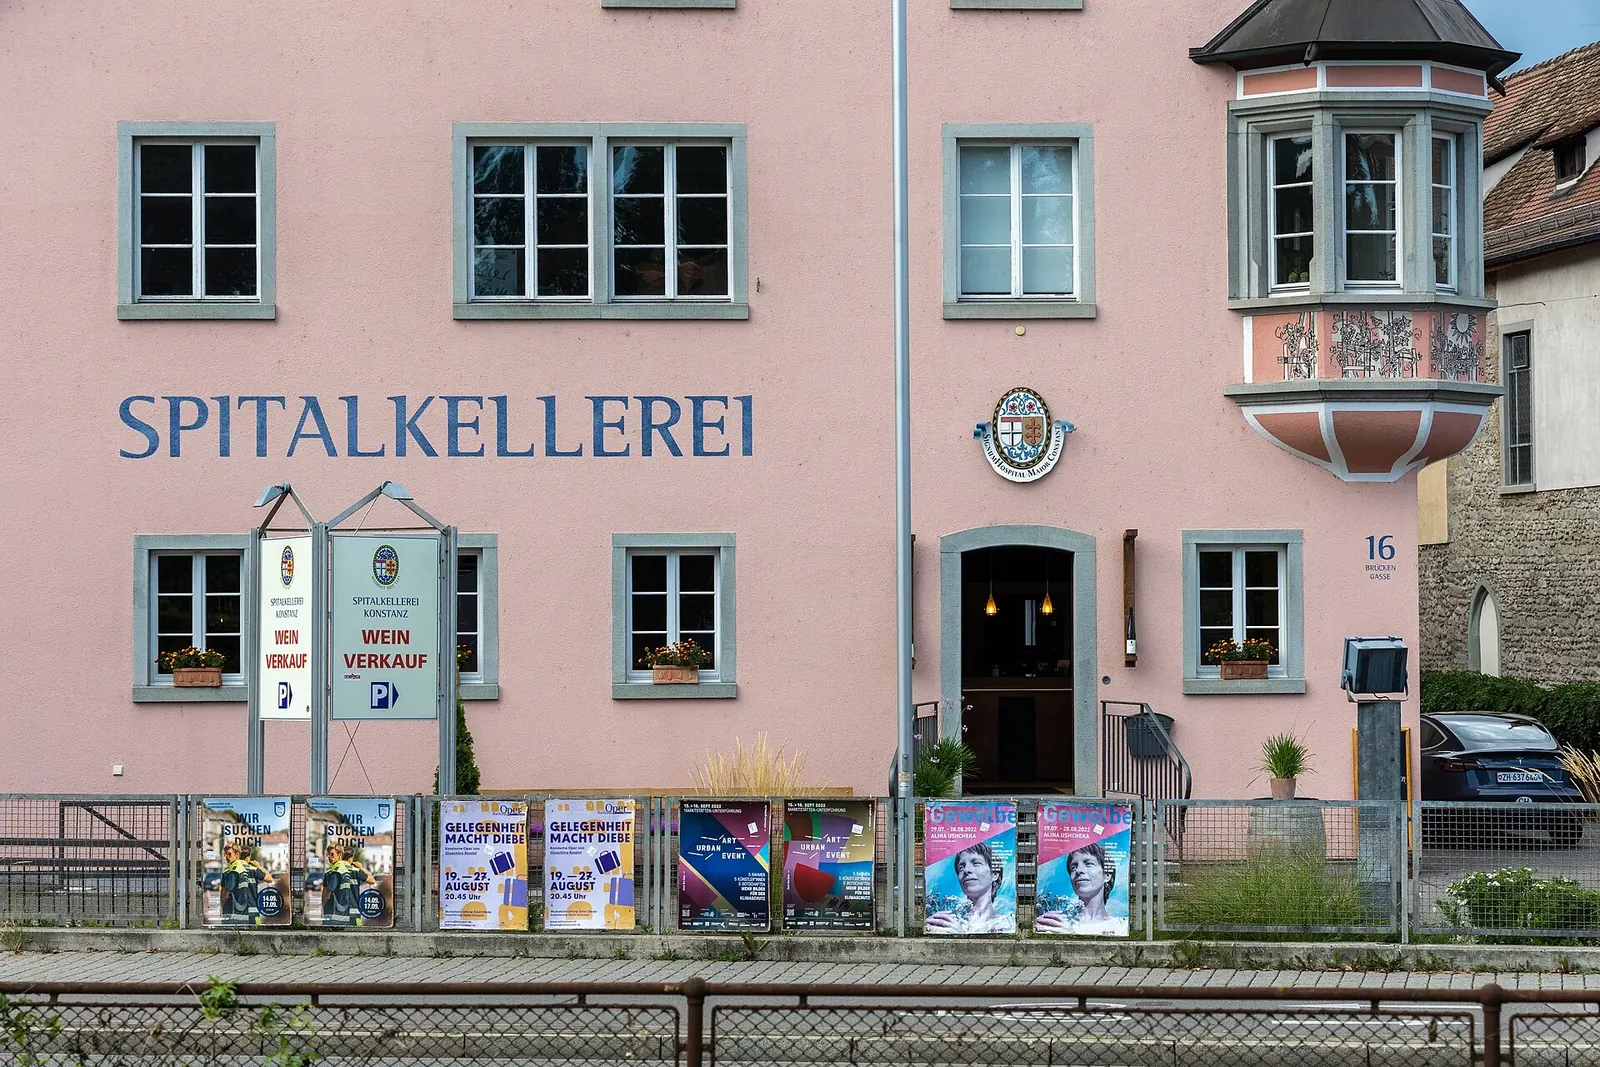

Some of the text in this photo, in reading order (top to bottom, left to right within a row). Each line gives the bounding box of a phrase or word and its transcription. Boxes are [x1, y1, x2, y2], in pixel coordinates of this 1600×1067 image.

[118, 395, 754, 459] SPITALKELLEREI
[1365, 535, 1395, 560] 16
[270, 597, 304, 606] SPITALKELLEREI
[352, 597, 419, 606] SPITALKELLEREI
[275, 609, 298, 618] KONSTANZ
[363, 609, 409, 618] KONSTANZ
[274, 630, 299, 645] WEIN
[361, 630, 410, 645] WEIN
[266, 653, 307, 669] VERKAUF
[343, 653, 427, 669] VERKAUF
[279, 684, 288, 707] P
[372, 684, 388, 707] P
[500, 805, 522, 816] Oper
[605, 803, 627, 814] Oper
[1043, 803, 1132, 825] Gewölbe
[236, 813, 259, 824] WIR
[339, 814, 363, 824] WIR
[224, 825, 271, 835] SUCHEN
[328, 825, 375, 836] SUCHEN
[445, 822, 525, 833] GELEGENHEIT
[550, 821, 631, 832] GELEGENHEIT
[235, 837, 262, 848] DICH
[338, 837, 365, 848] DICH
[445, 834, 525, 844] MACHT DIEBE
[550, 833, 630, 843] MACHT DIEBE
[445, 882, 490, 891] AUGUST
[550, 882, 596, 891] AUGUST
